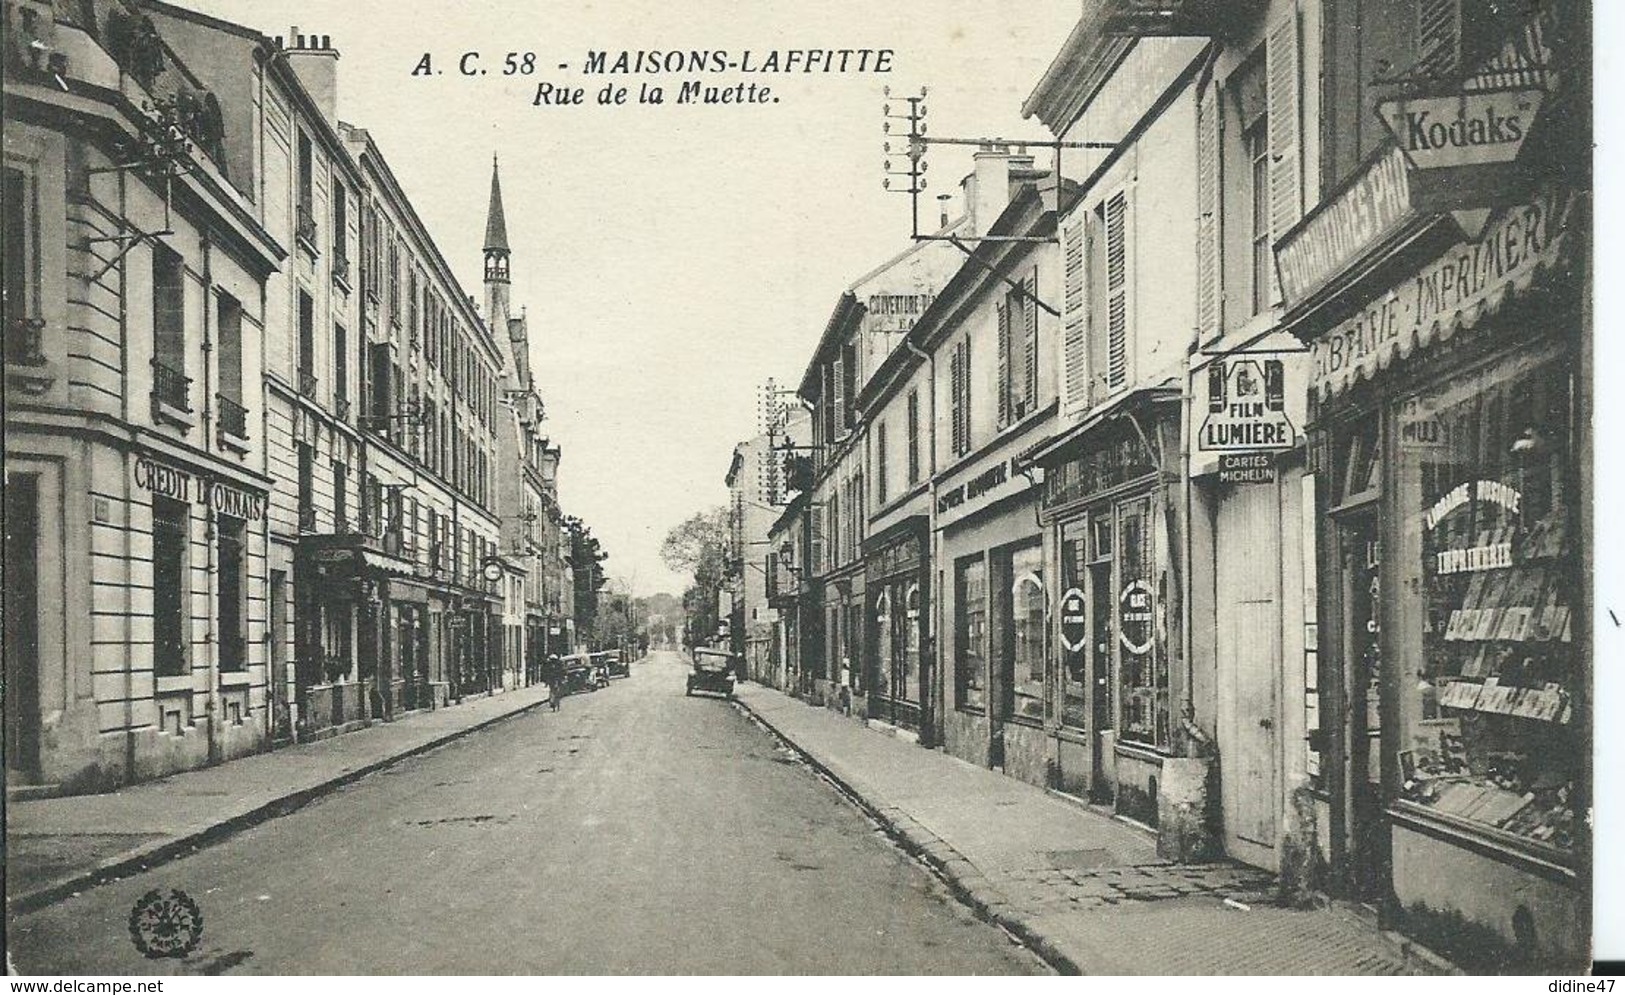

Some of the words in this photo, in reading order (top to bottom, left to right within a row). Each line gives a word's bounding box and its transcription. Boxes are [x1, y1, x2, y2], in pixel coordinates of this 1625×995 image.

[1207, 419, 1287, 446] LUMIÈRE
[1224, 456, 1269, 468] CARTES
[1220, 469, 1274, 482] MICHELIN
[134, 458, 190, 501] CREDIT
[196, 476, 261, 521] LONNAIS
